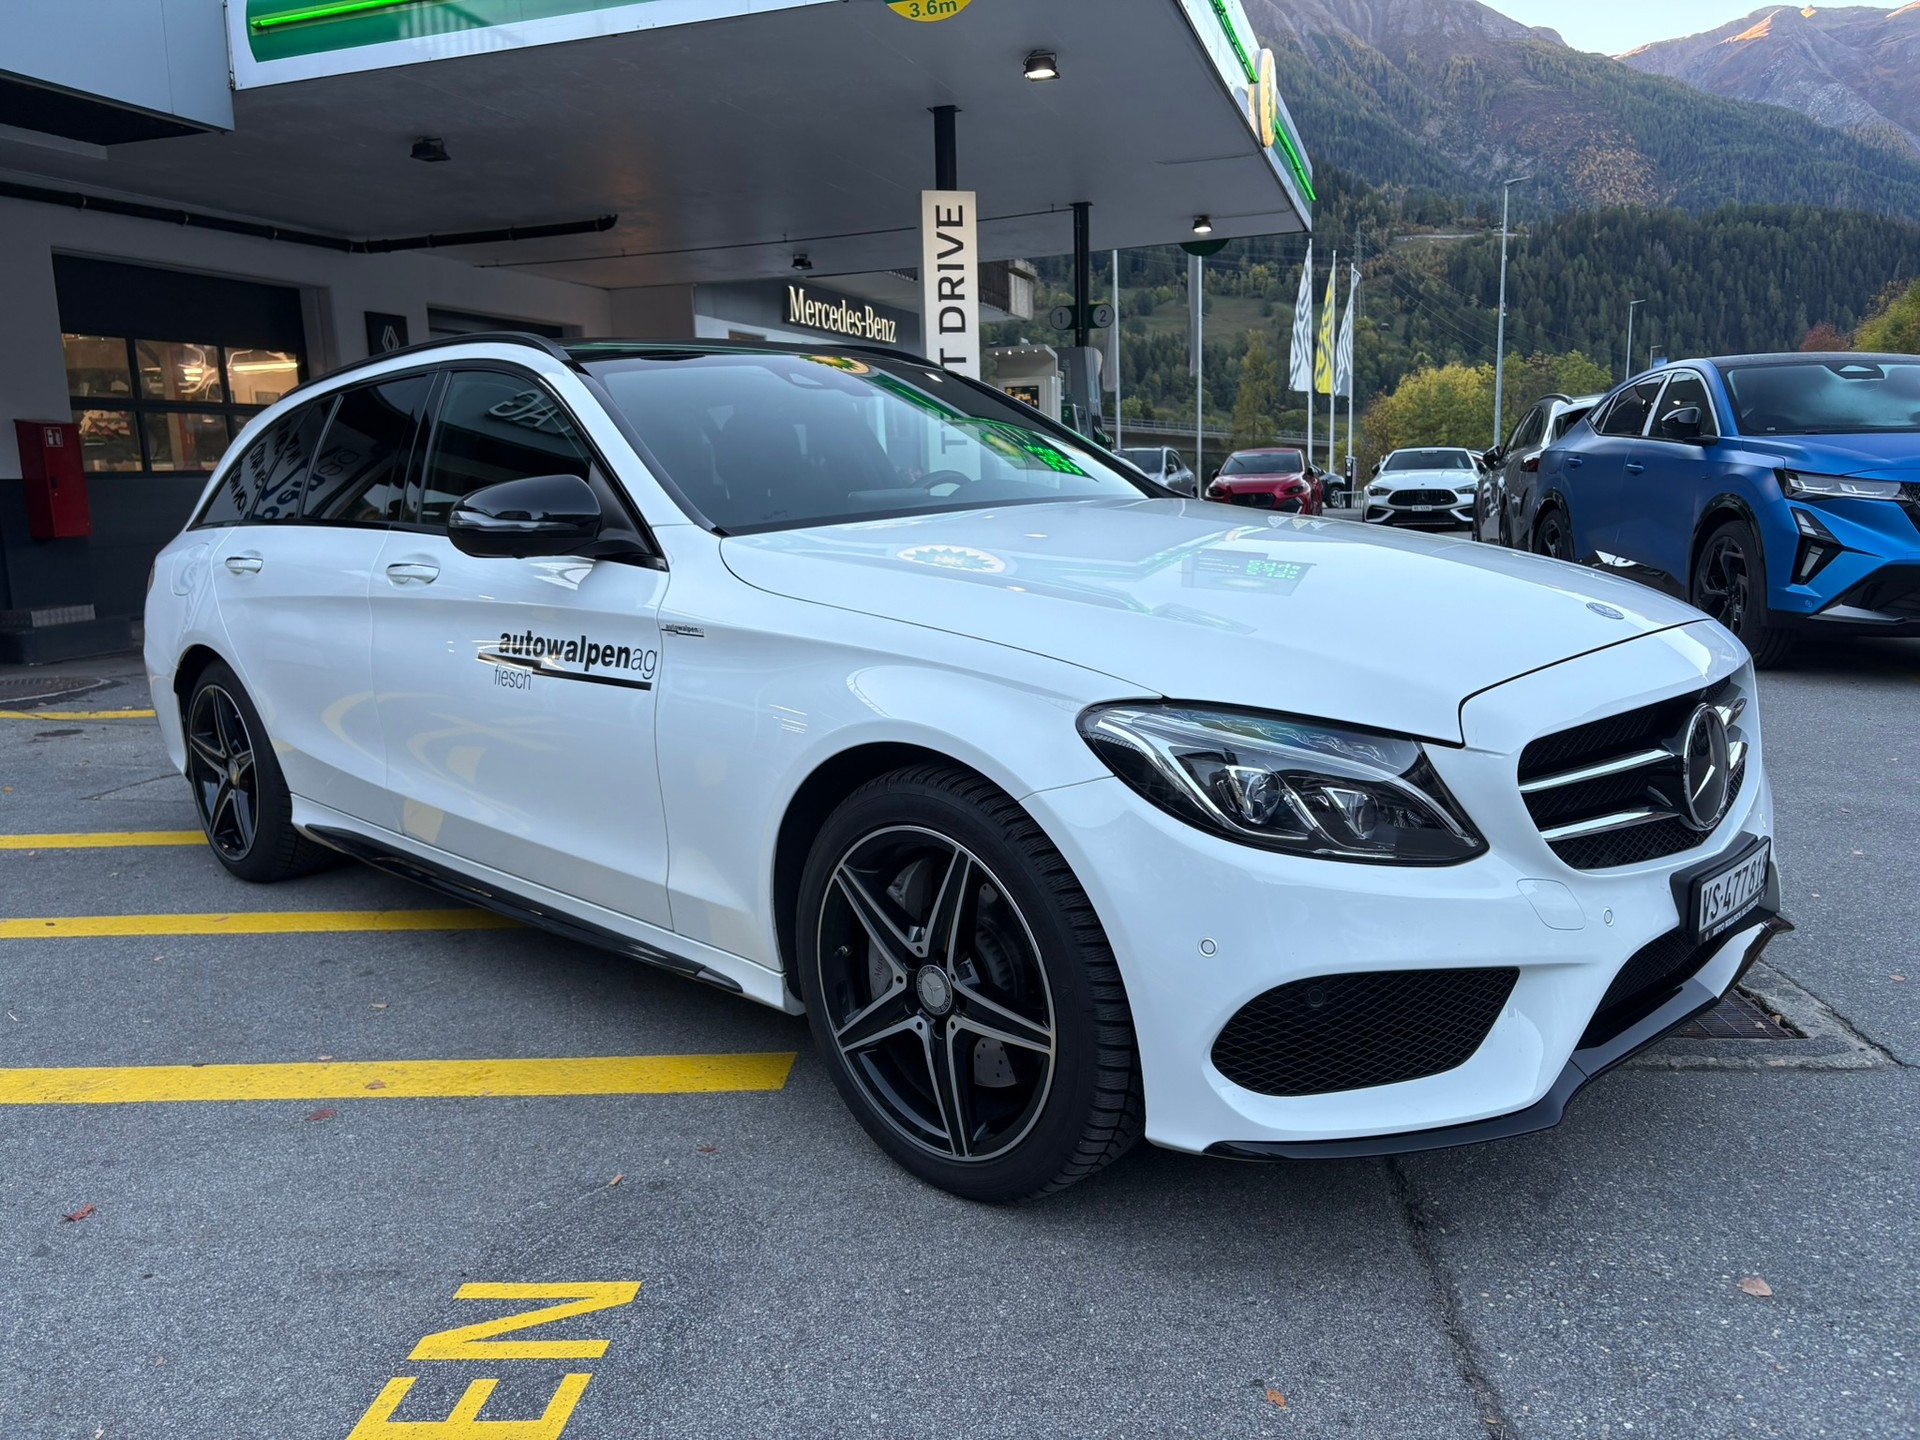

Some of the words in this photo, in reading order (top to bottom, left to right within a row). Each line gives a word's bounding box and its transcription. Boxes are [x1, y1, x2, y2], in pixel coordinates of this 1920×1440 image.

[909, 0, 957, 18] 3.6m
[935, 204, 966, 335] DRIVE
[788, 285, 897, 343] Mercedes-Benz
[494, 665, 532, 690] fiesch
